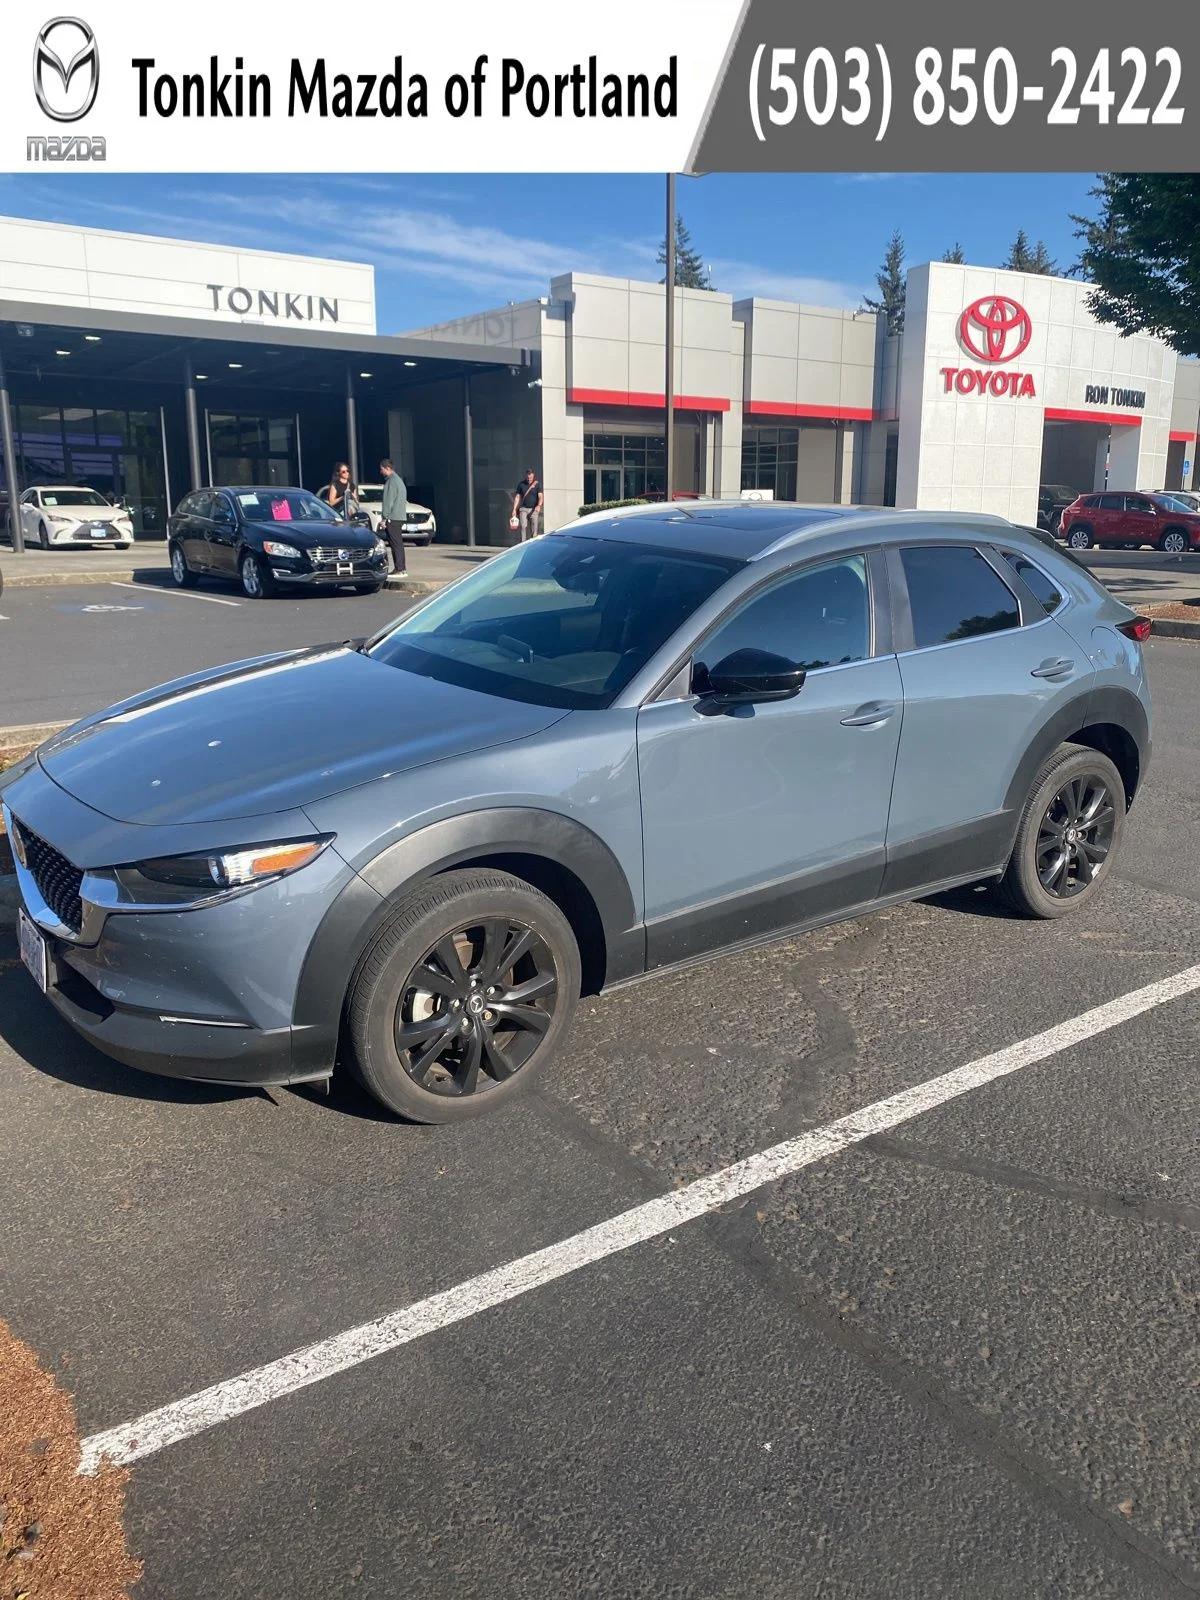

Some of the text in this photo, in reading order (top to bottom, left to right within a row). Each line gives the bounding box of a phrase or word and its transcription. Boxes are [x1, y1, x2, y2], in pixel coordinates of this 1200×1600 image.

[207, 284, 338, 323] TONKIN
[942, 366, 1036, 397] TOYOTA
[1085, 385, 1146, 408] RON TONKIN
